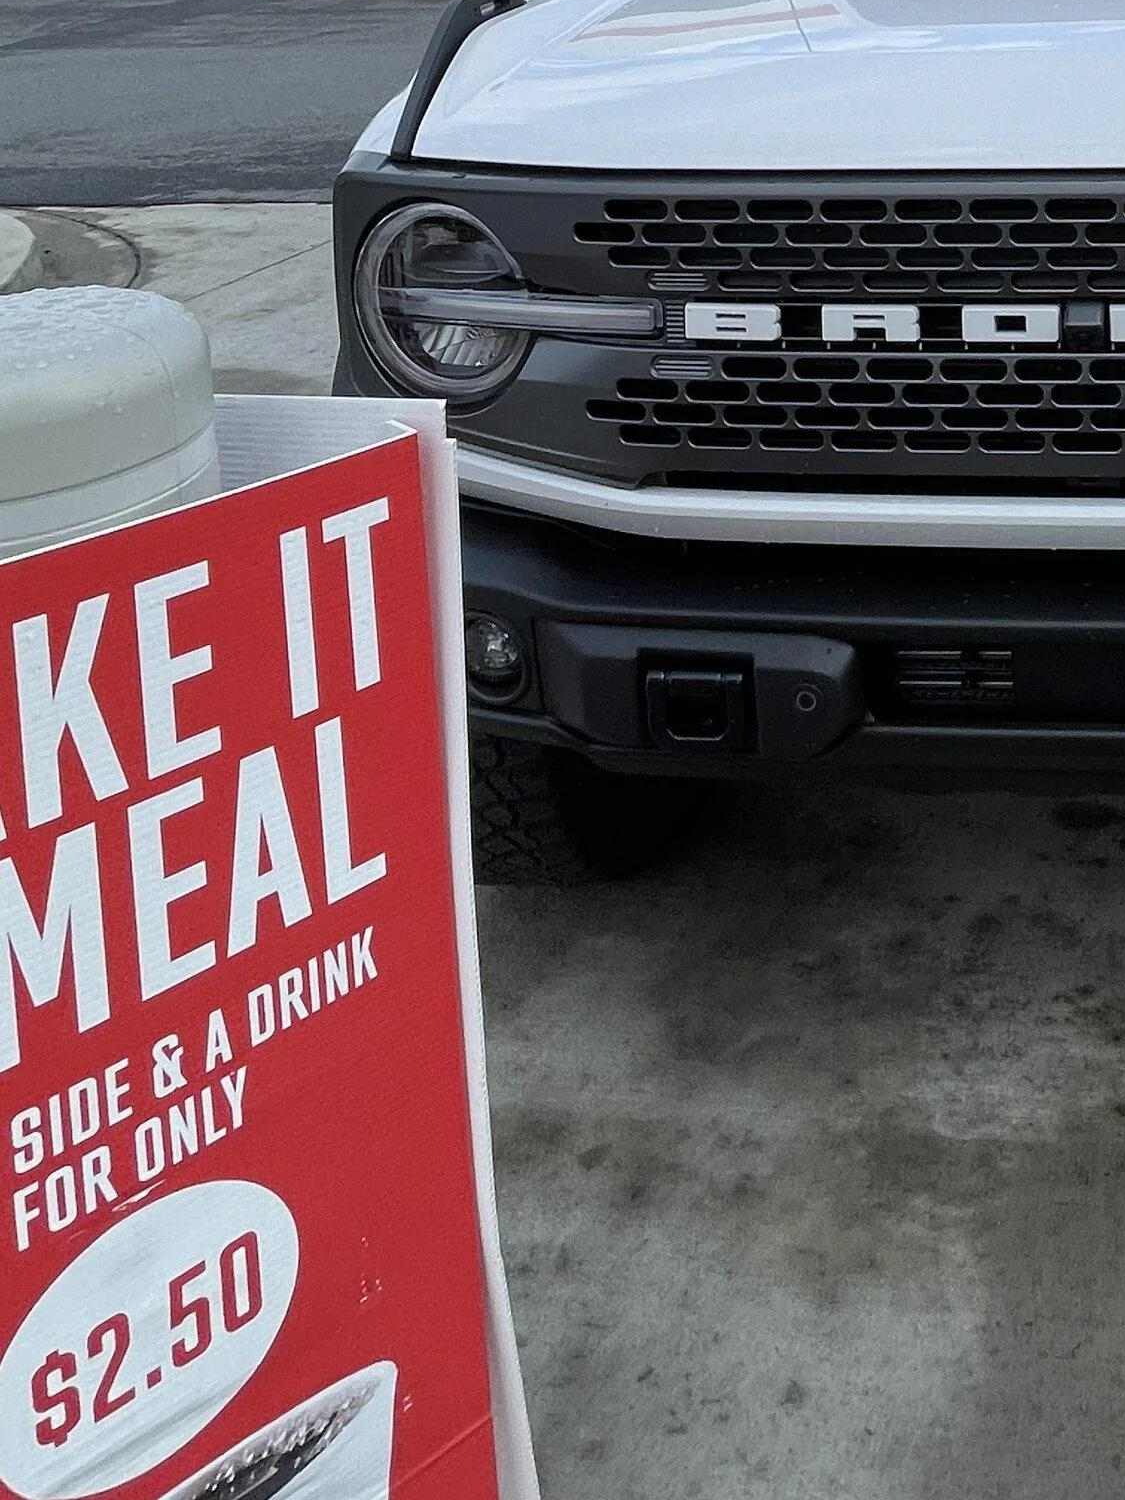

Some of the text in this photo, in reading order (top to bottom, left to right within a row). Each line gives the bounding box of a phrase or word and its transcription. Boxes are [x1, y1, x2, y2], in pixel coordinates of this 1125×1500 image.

[0, 496, 390, 841] KE IT
[0, 716, 387, 1073] MEAL
[10, 926, 378, 1175] SIDE & A DRINK
[13, 1065, 247, 1252] FOR ONLY
[29, 1230, 263, 1448] $2.50
